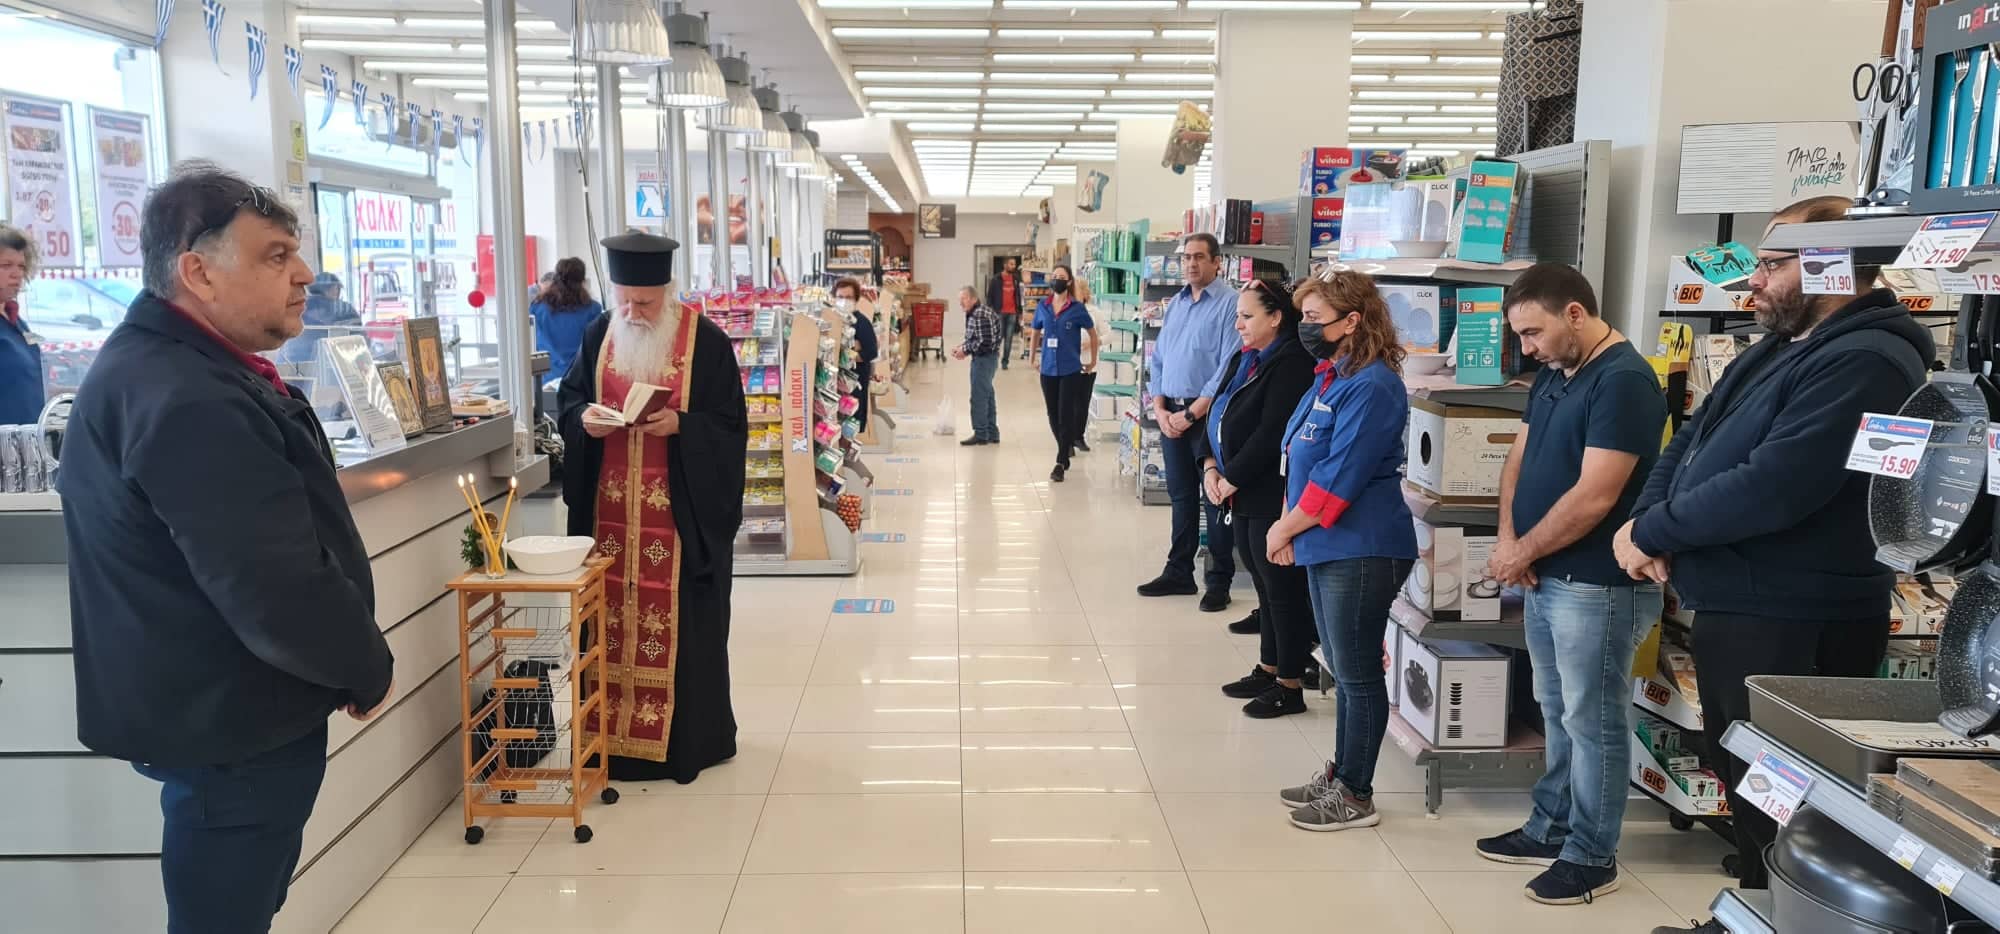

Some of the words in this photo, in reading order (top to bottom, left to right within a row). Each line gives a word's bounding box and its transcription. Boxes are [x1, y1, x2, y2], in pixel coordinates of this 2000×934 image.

[1320, 154, 1349, 164] vileda
[1317, 206, 1343, 216] viled
[1924, 248, 1967, 264] 21.90
[1824, 275, 1851, 290] 21.90
[1680, 287, 1702, 300] BIC
[1881, 455, 1917, 475] 15.90
[1647, 684, 1669, 702] BIC
[1644, 772, 1665, 790] BIC
[1762, 795, 1791, 822] 11.30
